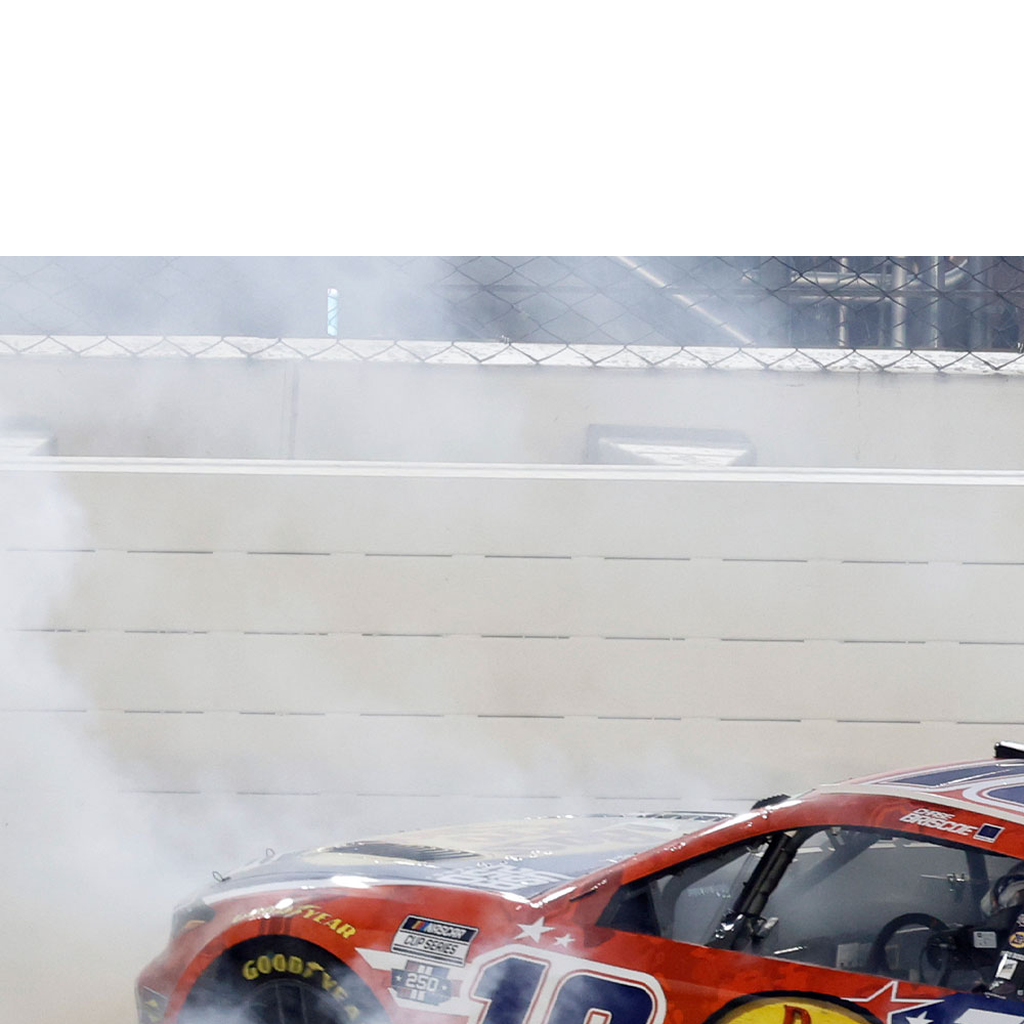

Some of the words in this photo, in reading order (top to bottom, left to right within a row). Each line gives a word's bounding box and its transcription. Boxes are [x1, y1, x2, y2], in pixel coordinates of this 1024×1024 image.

[424, 922, 467, 939] NASCAR
[404, 934, 424, 948] CUP
[423, 939, 459, 955] SERIES
[405, 973, 439, 991] 250
